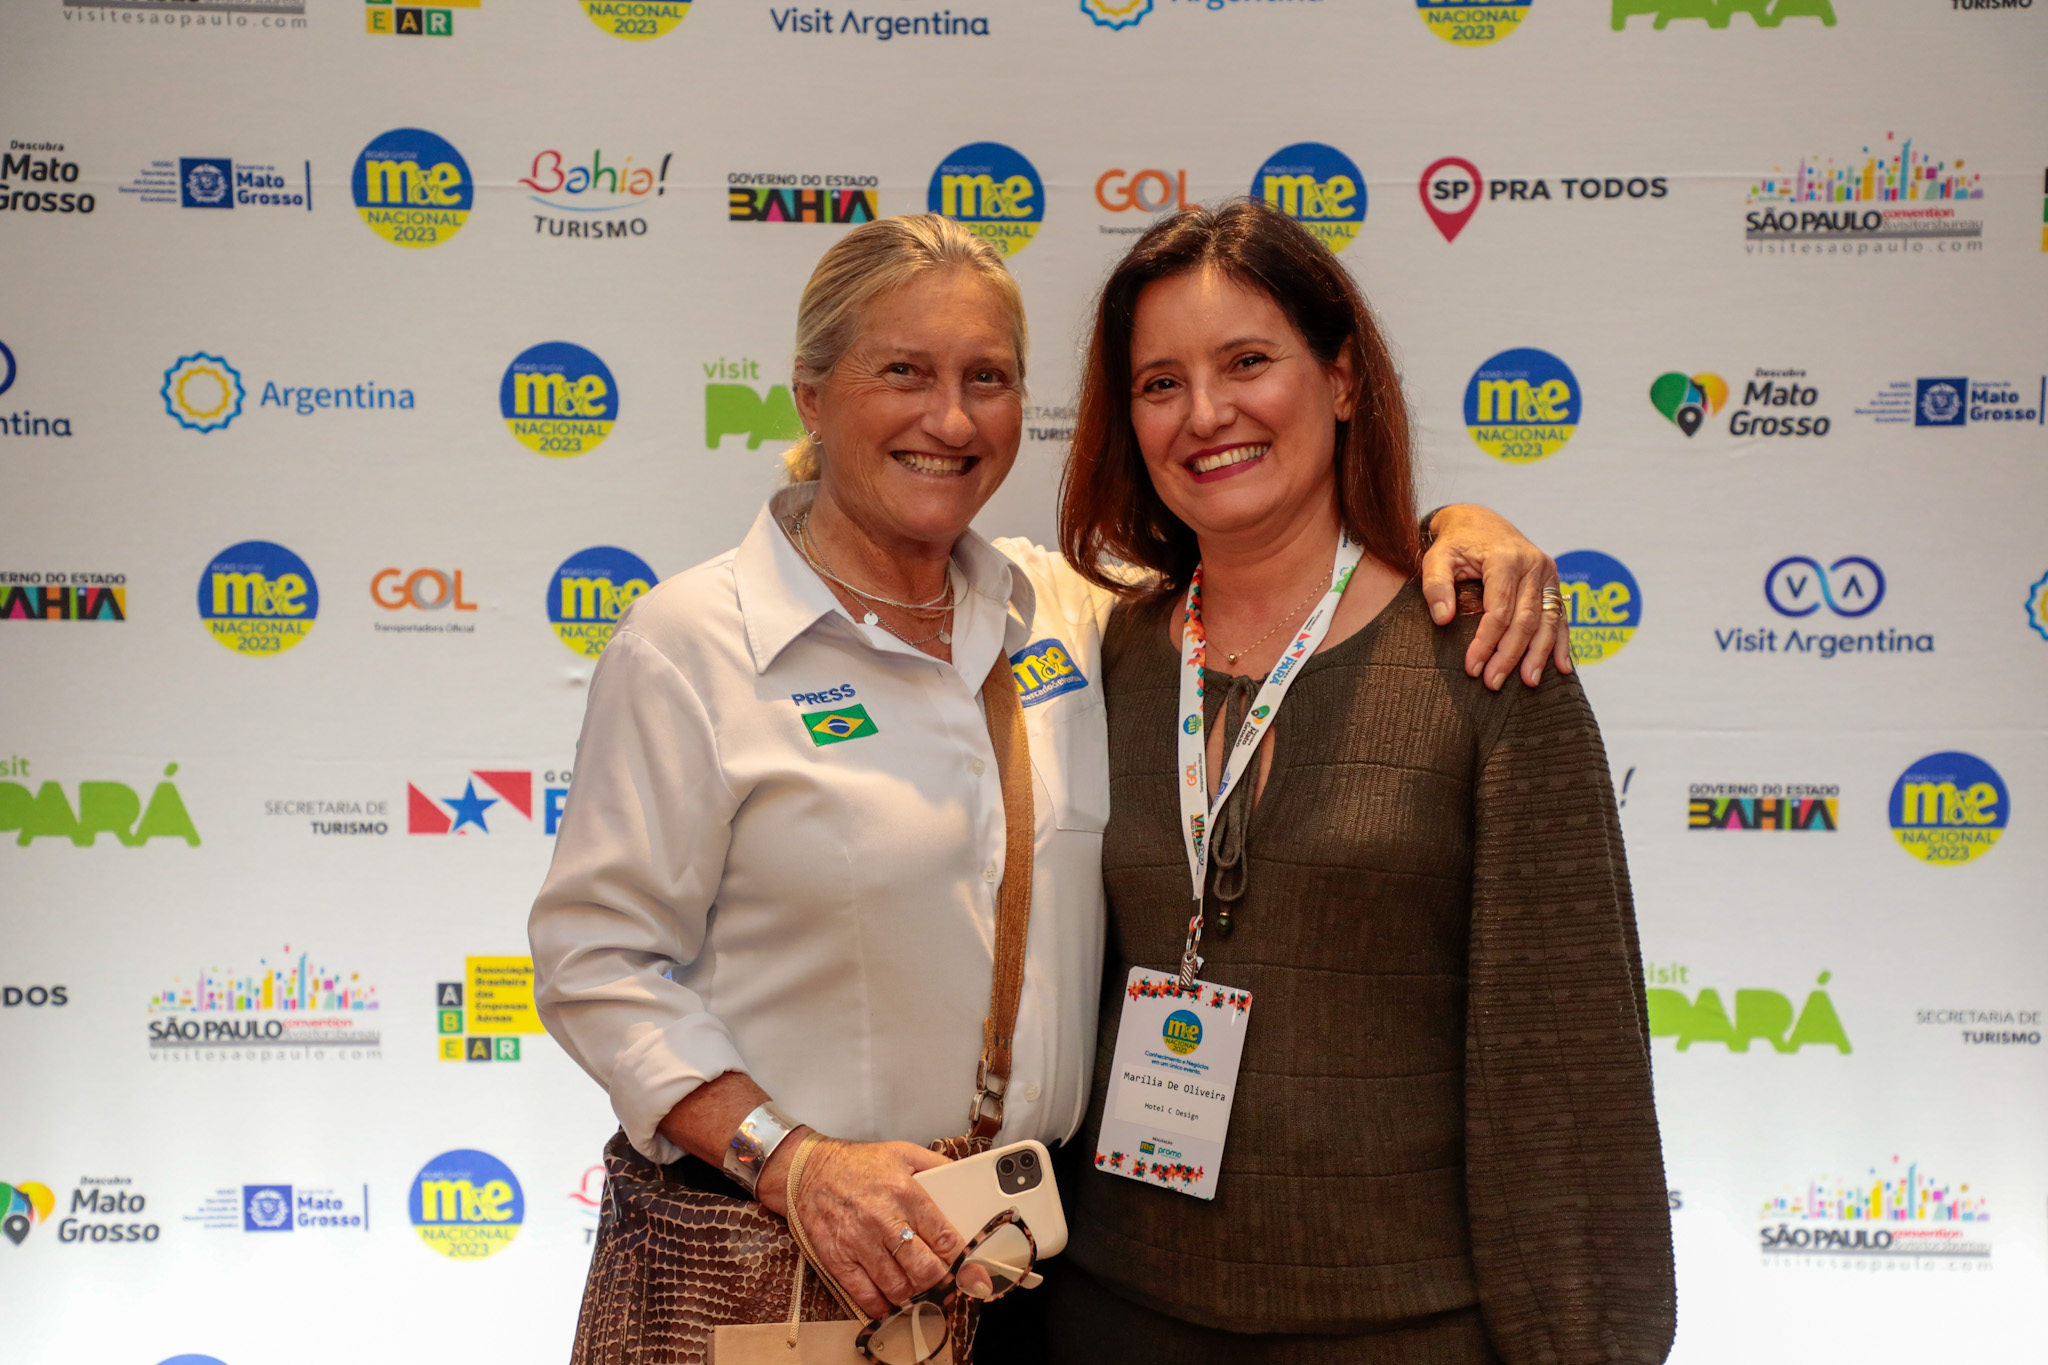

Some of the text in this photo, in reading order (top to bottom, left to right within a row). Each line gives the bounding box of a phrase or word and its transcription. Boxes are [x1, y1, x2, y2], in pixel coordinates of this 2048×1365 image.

[589, 3, 682, 18] NACIONAL
[1428, 8, 1521, 23] NACIONAL
[614, 19, 657, 34] 2023
[770, 8, 989, 40] Visit Argentina
[1452, 24, 1495, 40] 2023
[1, 154, 79, 183] Mato
[518, 148, 673, 197] Bahia!
[236, 172, 285, 188] Mato
[728, 173, 878, 187] GOVERNO DO ESTADO
[1095, 168, 1201, 213] GOL
[1433, 177, 1668, 200] SP PRA TODOS
[237, 190, 303, 205] Grosso
[367, 211, 462, 227] NACIONAL
[534, 215, 647, 238] TURISMO
[1746, 206, 1882, 231] SÃO PAULO
[394, 227, 437, 242] 2023
[968, 224, 1033, 238] CIONAL
[703, 357, 760, 380] visit
[260, 381, 416, 416] Argentina
[1743, 380, 1818, 407] Mato
[1970, 389, 2020, 404] Mato
[1970, 406, 2037, 421] Grosso
[0, 410, 72, 436] ntina
[514, 421, 606, 438] NACIONAL
[1729, 410, 1831, 436] Grosso
[1476, 427, 1567, 442] NACIONAL
[539, 437, 583, 452] 2023
[1501, 442, 1543, 457] 2023
[0, 572, 126, 584] ERNO DO ESTADO
[370, 567, 478, 611] GOL
[0, 586, 126, 621] AHIA
[212, 621, 306, 636] NACIONAL
[561, 625, 613, 639] NACIO
[236, 636, 281, 651] 2023
[584, 640, 606, 654] 20
[1715, 627, 1935, 658] Visit Argentina
[791, 684, 856, 707] PRESS
[0, 754, 30, 777] sit
[1186, 761, 1198, 787] GOL
[1689, 784, 1840, 797] GOVERNO DO ESTADO
[265, 800, 387, 816] SECRETARIA DE
[1688, 797, 1839, 831] BAHIA
[311, 822, 388, 835] TURISMO
[1903, 829, 1995, 845] NACIONAL
[1925, 845, 1970, 861] 2023
[1645, 963, 1689, 984] isit
[2, 985, 68, 1008] DOS
[1646, 970, 1853, 1054] PARÁ
[1916, 1010, 2041, 1025] SECRETARIA DE
[149, 1016, 283, 1041] SÃO PAULO
[1962, 1031, 2041, 1044] TURISMO
[1145, 1050, 1182, 1064] Conhecimento
[1123, 1071, 1226, 1102] Marília De Oliveira
[1144, 1102, 1164, 1113] Hotel
[1175, 1109, 1199, 1121] Design
[1157, 1147, 1182, 1159] promo
[70, 1189, 146, 1214] Mato
[297, 1196, 343, 1210] Mato
[297, 1213, 361, 1227] Grosso
[57, 1218, 160, 1243] Grosso
[1761, 1224, 1894, 1249] SÃO PAULO
